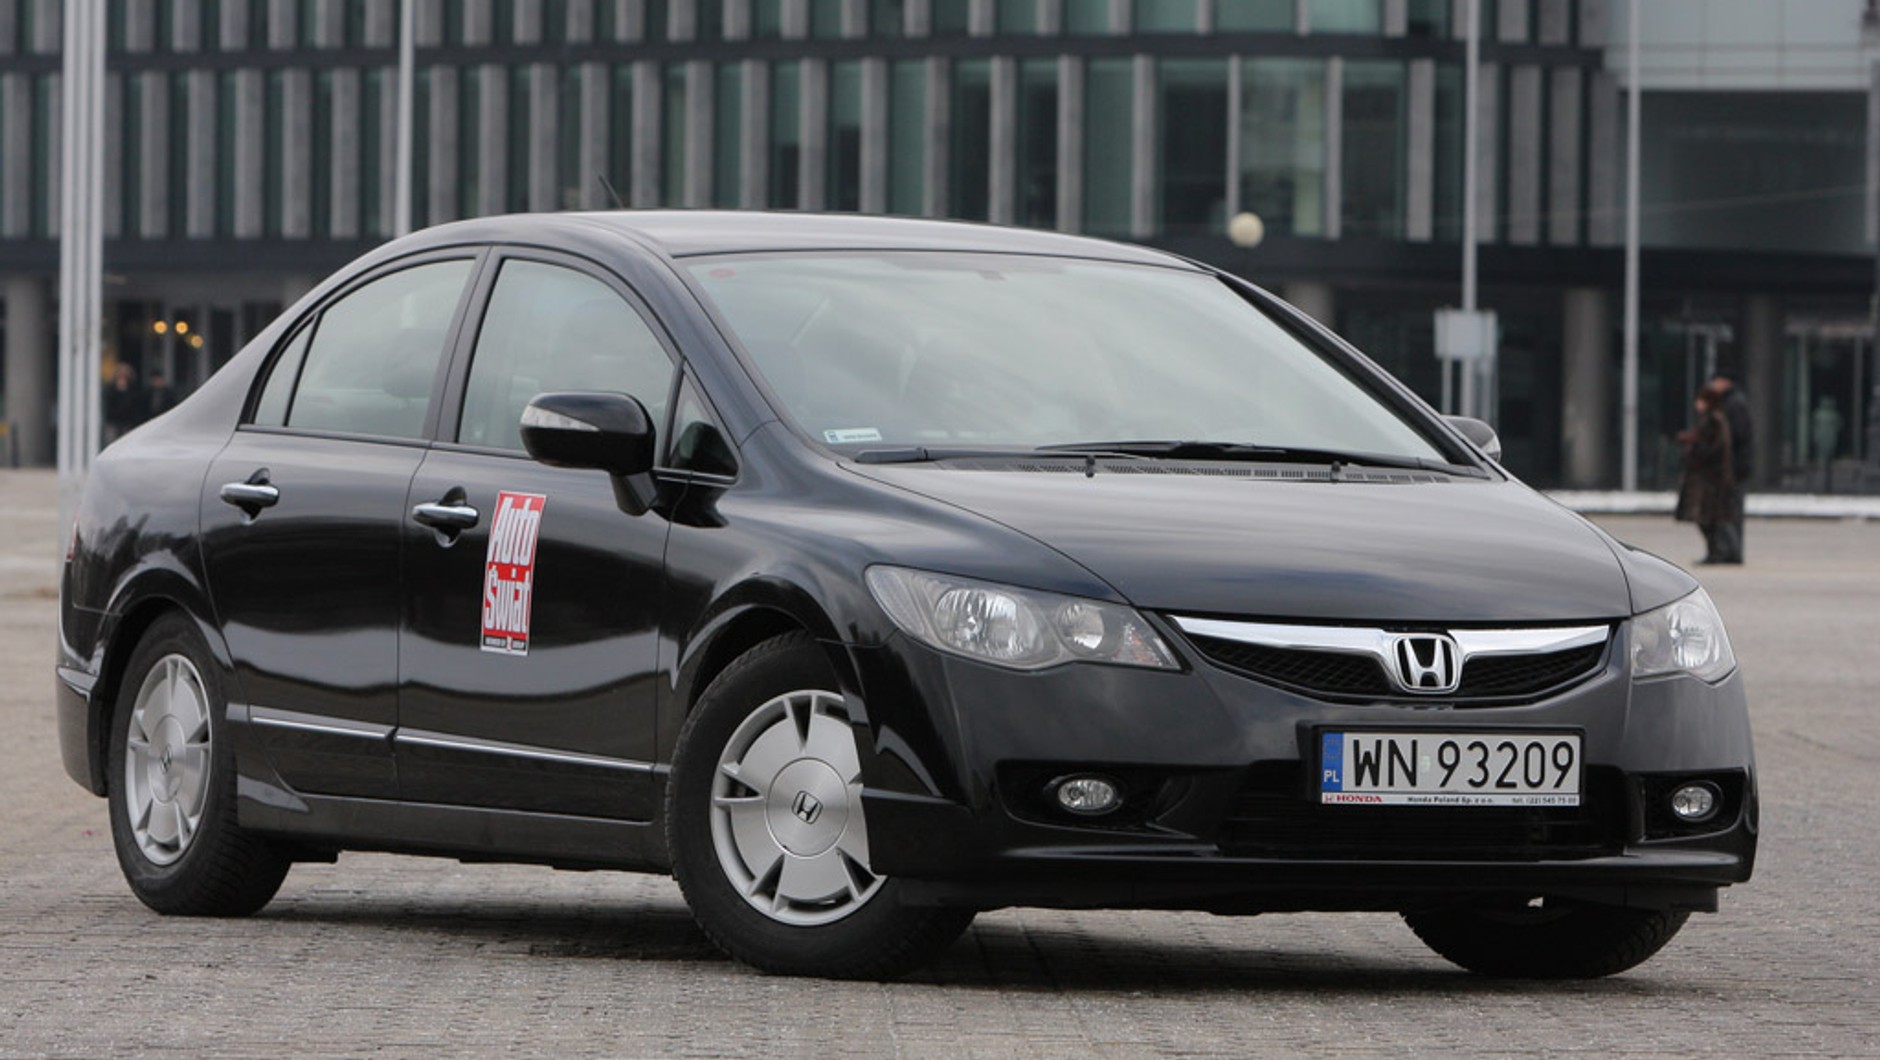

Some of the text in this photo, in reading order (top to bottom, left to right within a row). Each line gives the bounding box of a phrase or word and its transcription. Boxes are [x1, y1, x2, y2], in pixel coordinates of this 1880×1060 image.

[487, 497, 540, 566] Auto
[485, 565, 530, 634] Świat
[1323, 770, 1340, 783] PL
[1353, 739, 1575, 789] WN 93209
[1336, 794, 1382, 803] HONDA
